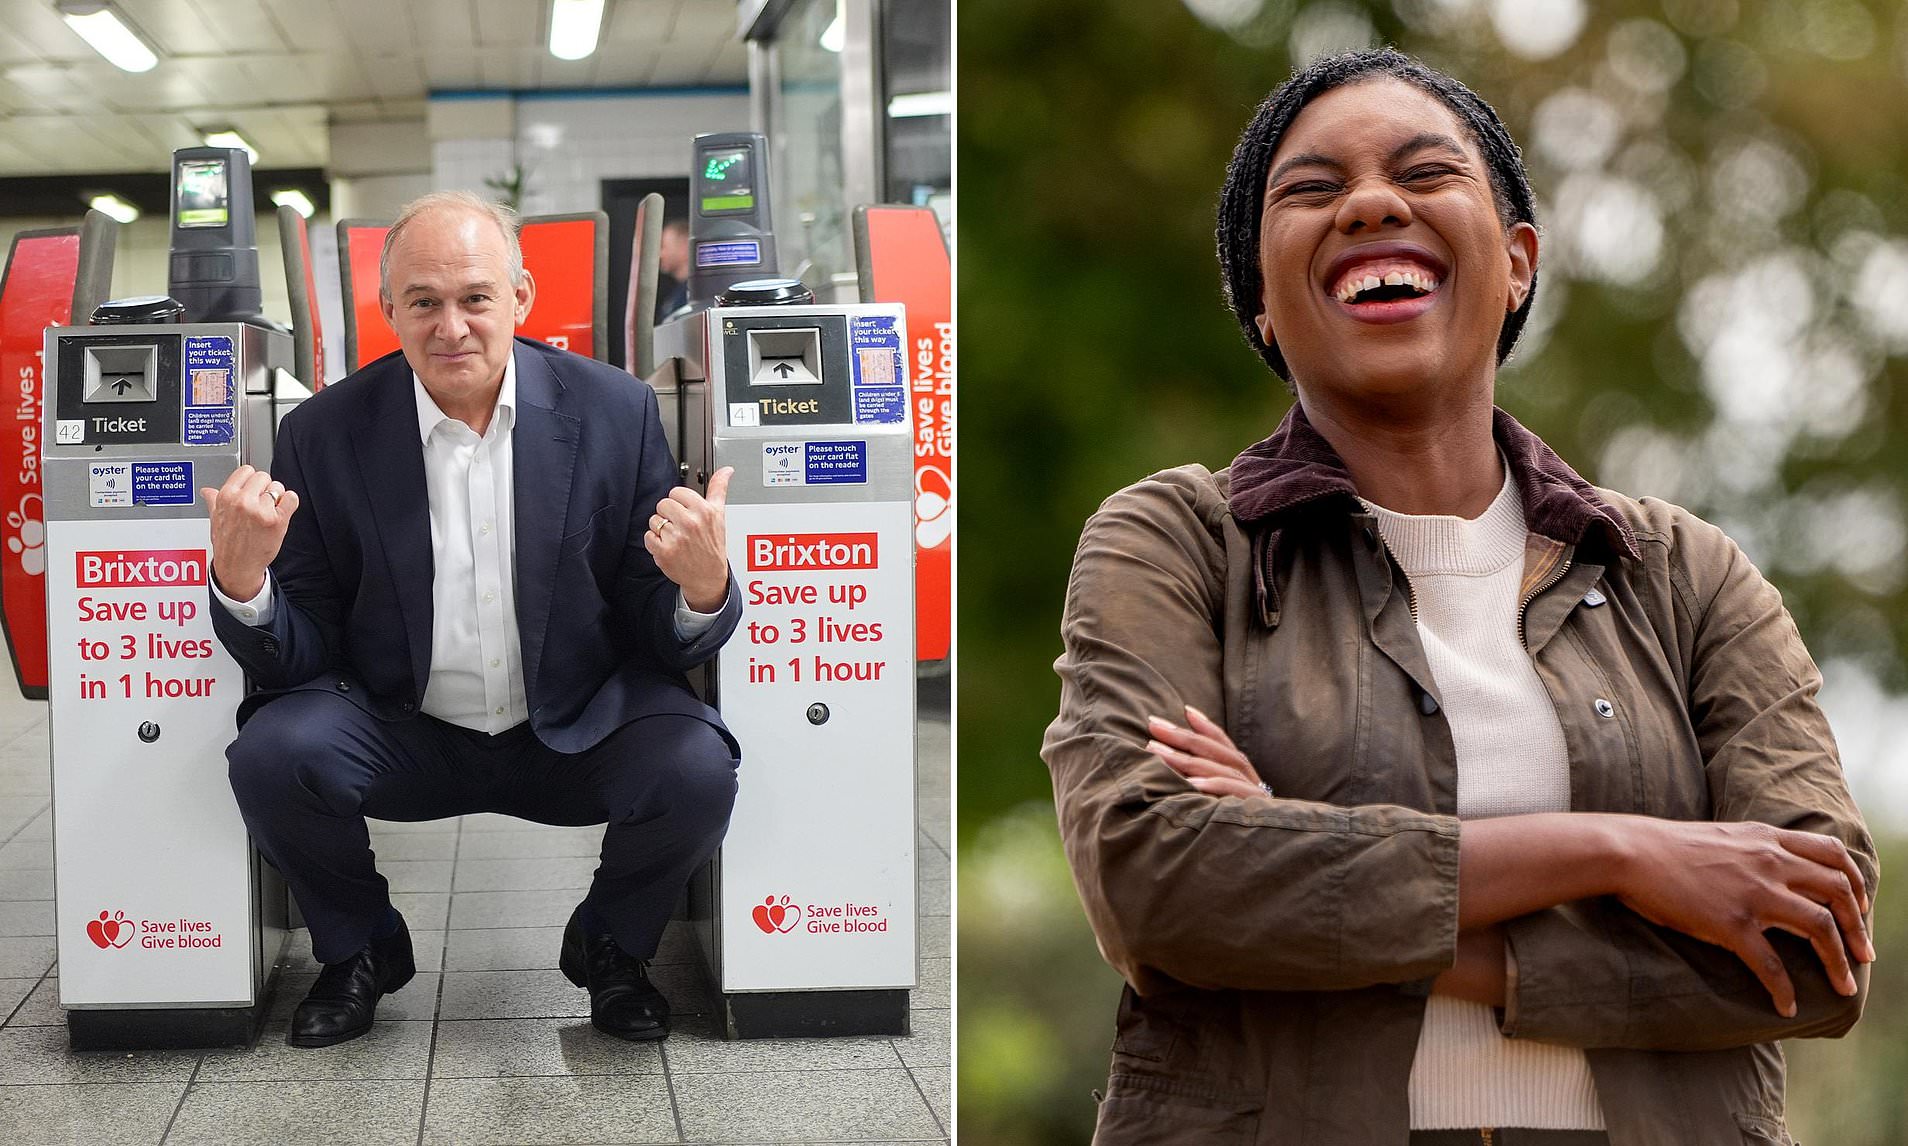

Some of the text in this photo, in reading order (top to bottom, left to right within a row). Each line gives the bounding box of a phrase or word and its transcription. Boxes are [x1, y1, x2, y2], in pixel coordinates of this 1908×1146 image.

[854, 327, 896, 337] your ticket
[871, 337, 886, 345] way
[189, 357, 220, 365] this way
[934, 321, 951, 396] blood
[914, 337, 935, 458] Save lives
[759, 398, 818, 414] Ticket
[734, 407, 755, 423] 41
[16, 365, 37, 484] Save lives
[59, 424, 80, 440] 42
[92, 417, 147, 433] Ticket
[765, 445, 799, 457] oyster
[809, 444, 857, 453] Please touch
[809, 454, 826, 462] your
[821, 461, 834, 469] the
[93, 466, 126, 477] oyster
[161, 465, 183, 473] touch
[136, 475, 153, 483] your
[753, 537, 871, 567] Brixton
[83, 555, 200, 583] Brixton
[748, 580, 867, 610] Save up
[78, 597, 197, 627] Save up
[747, 617, 883, 645] to 3 lives
[78, 633, 213, 661] to 3 lives
[749, 655, 886, 684] in 1 hour
[80, 672, 216, 700] in 1 hour
[807, 903, 878, 918] Save lives
[141, 919, 212, 933] Save lives
[807, 918, 887, 934] Give blood
[141, 934, 222, 949] Give blood
